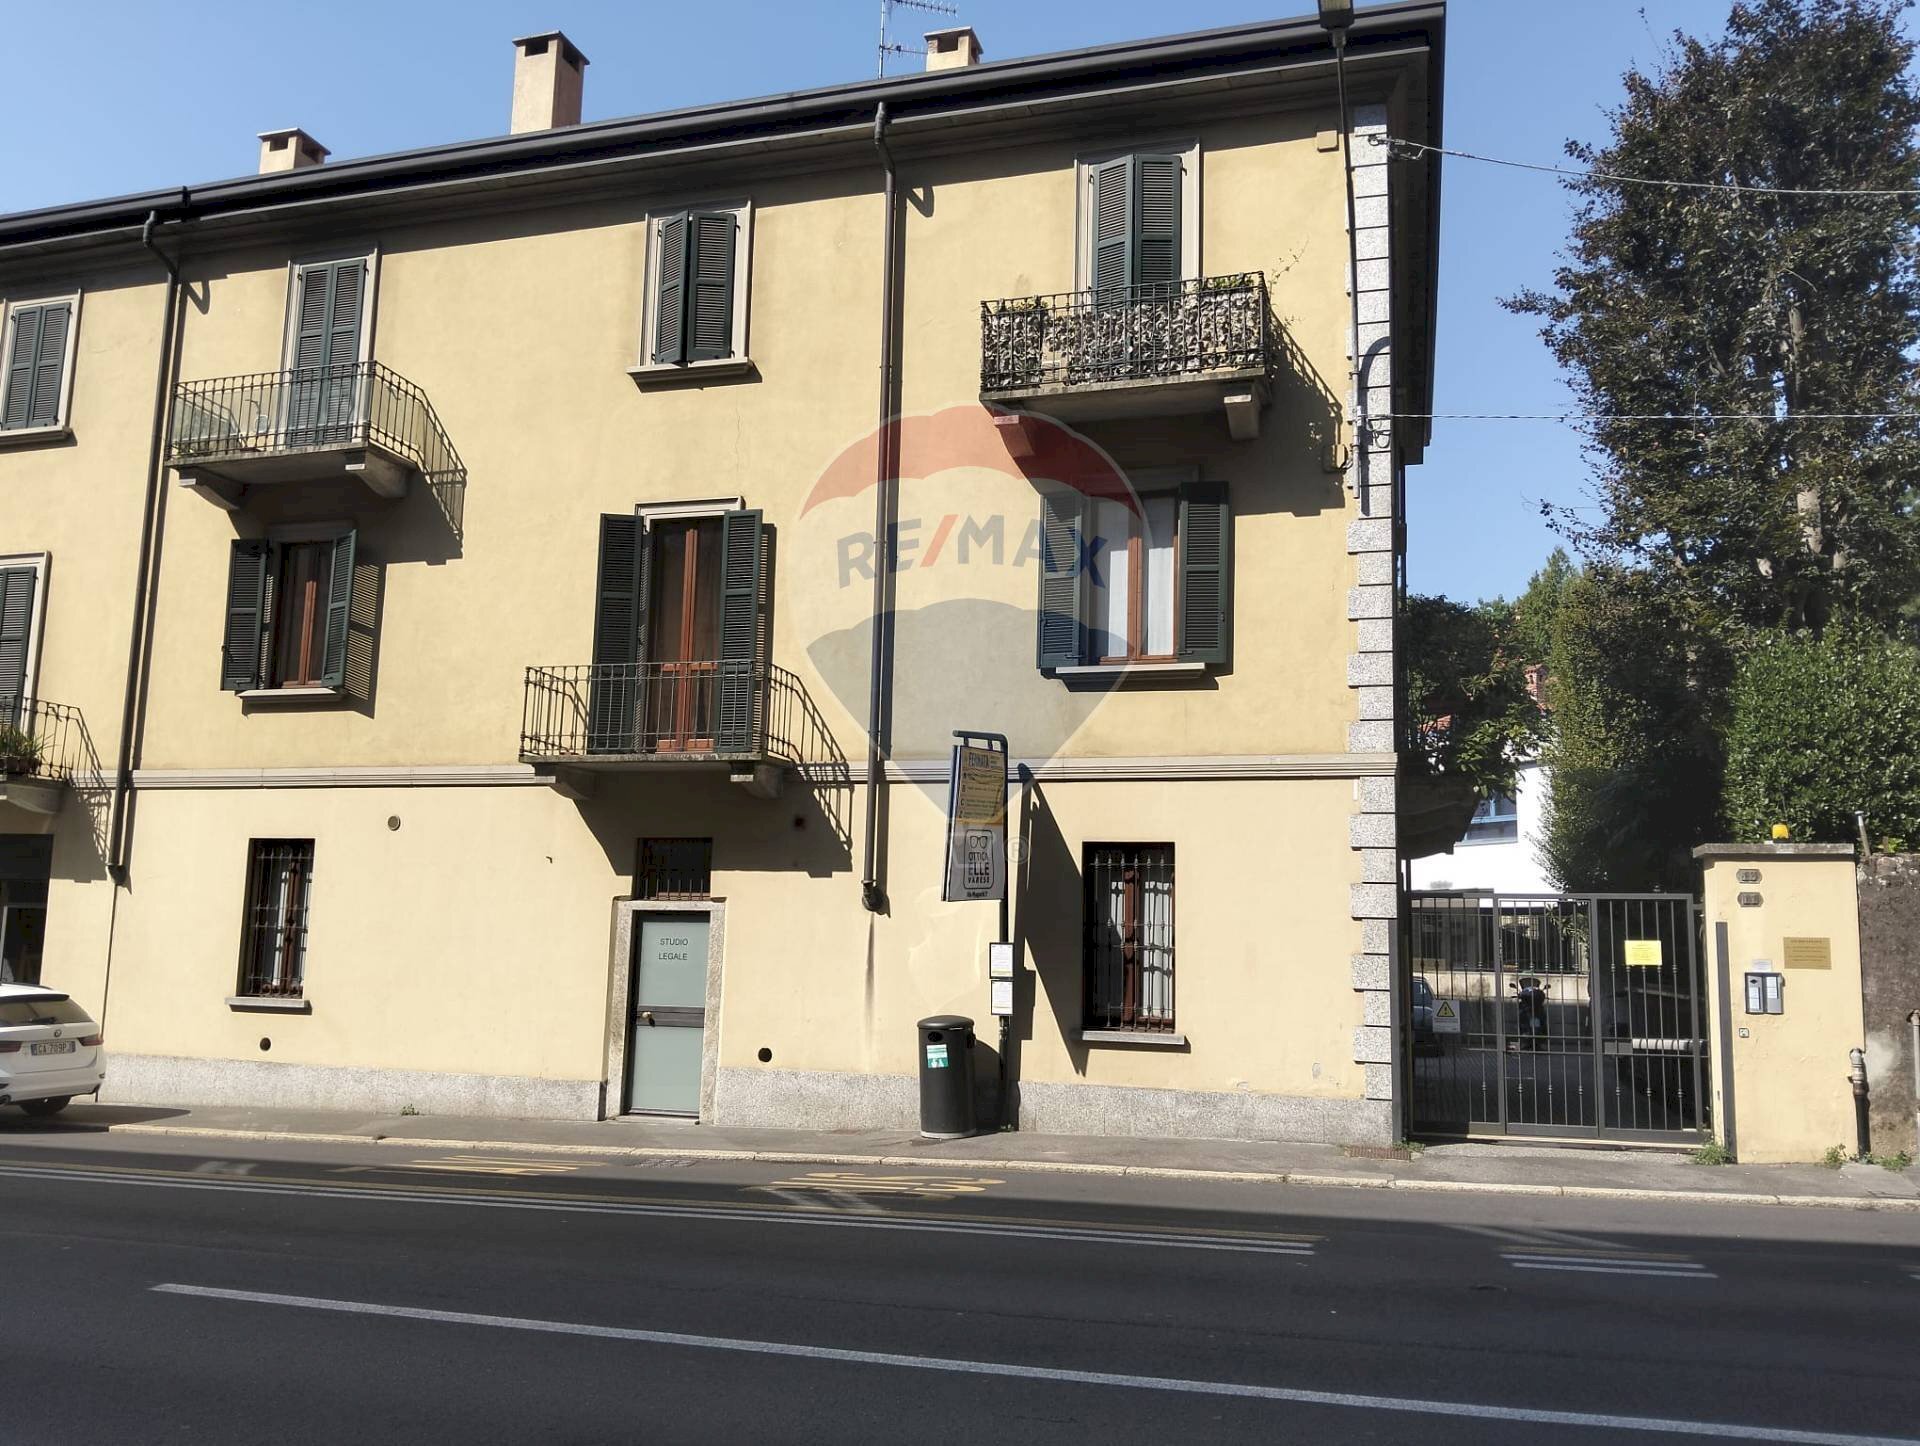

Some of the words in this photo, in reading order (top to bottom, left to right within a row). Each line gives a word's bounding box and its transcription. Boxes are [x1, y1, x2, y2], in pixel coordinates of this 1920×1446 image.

[968, 851, 989, 861] OTTICA
[968, 862, 990, 876] ELLE
[967, 876, 990, 884] VARESE
[660, 938, 689, 946] STUDIO
[658, 952, 688, 960] LEGALE
